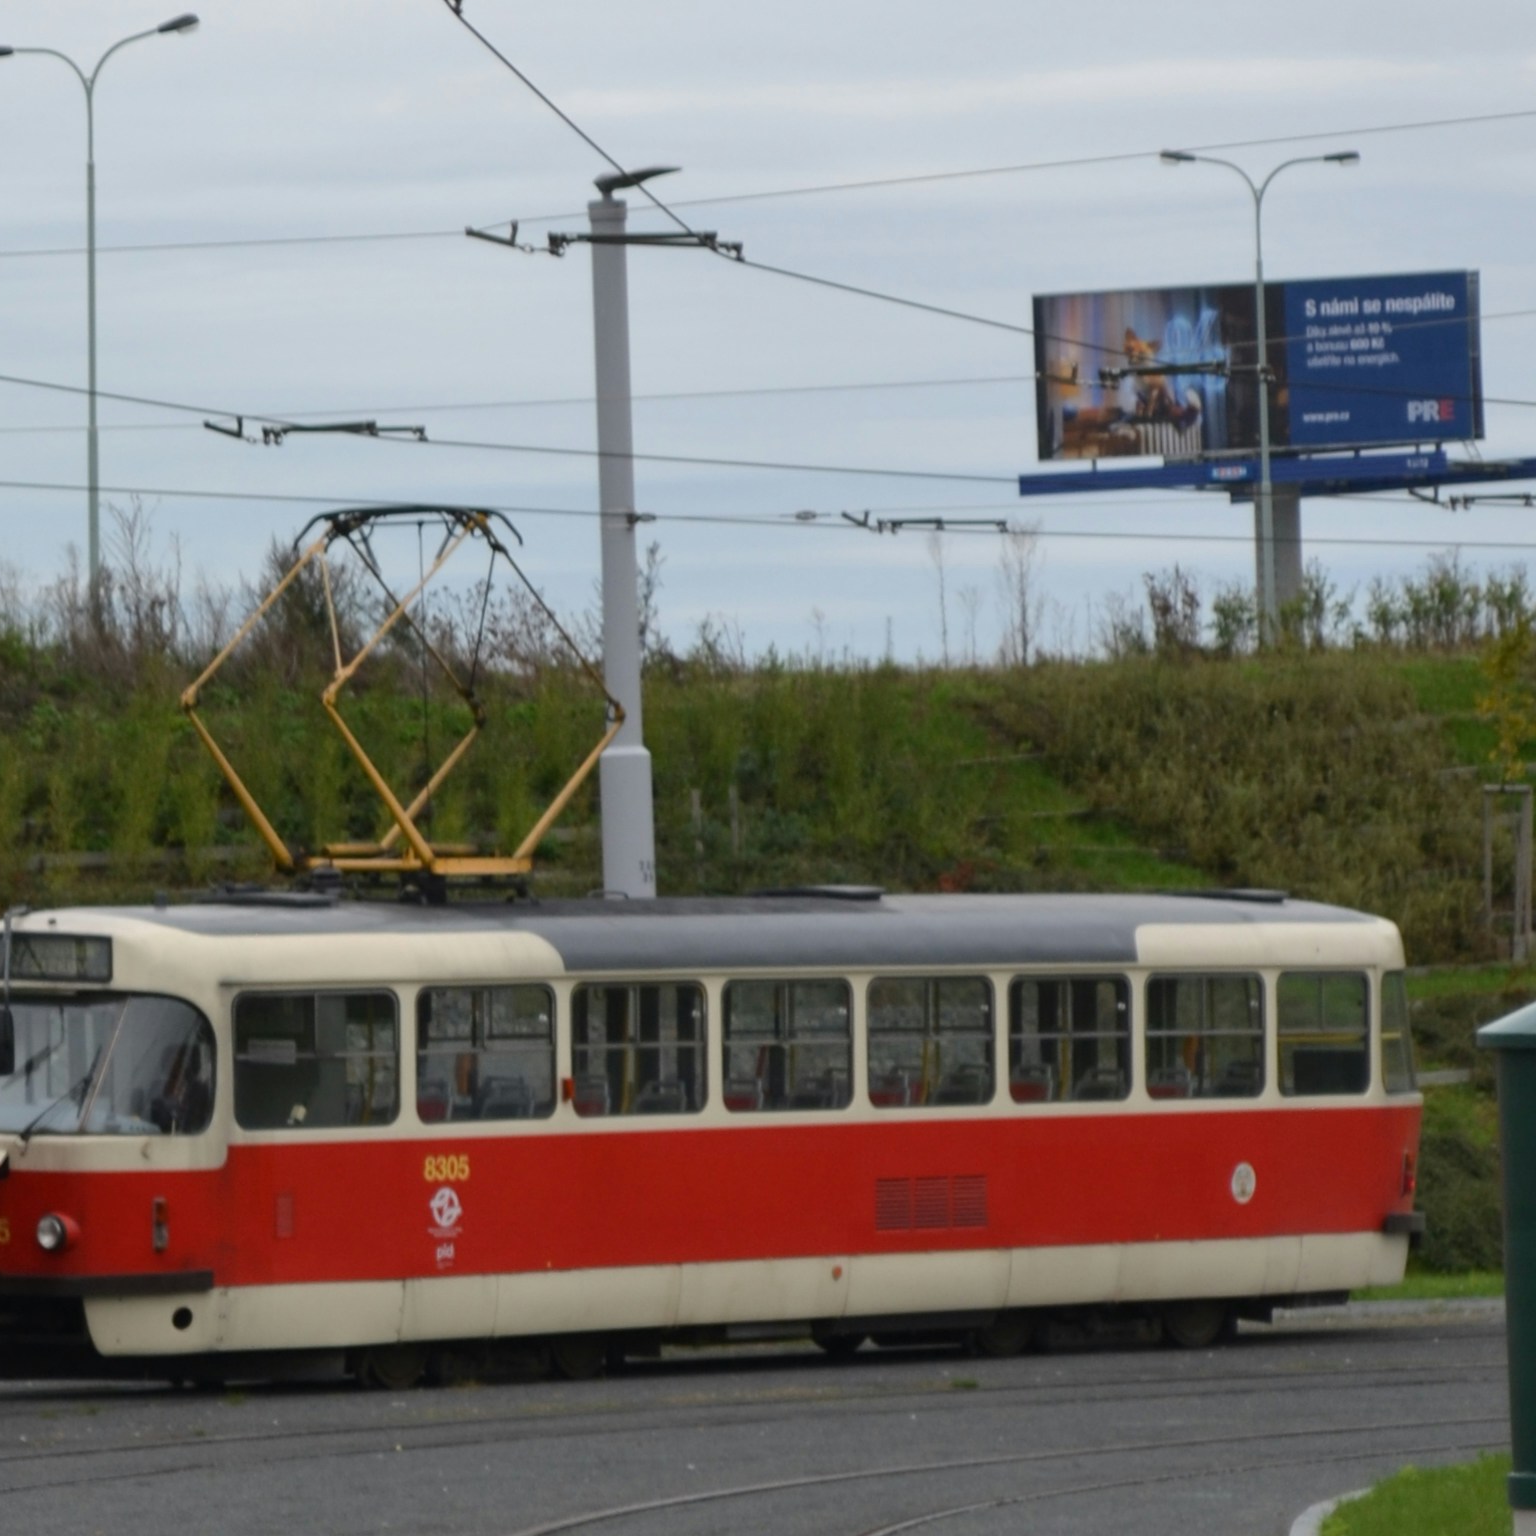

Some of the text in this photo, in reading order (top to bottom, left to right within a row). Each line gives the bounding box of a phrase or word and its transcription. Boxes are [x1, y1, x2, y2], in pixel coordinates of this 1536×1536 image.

[1305, 298, 1317, 318] S
[1320, 297, 1359, 317] námi
[1362, 298, 1382, 315] se
[1407, 398, 1455, 423] PRE
[424, 1155, 470, 1182] 8305
